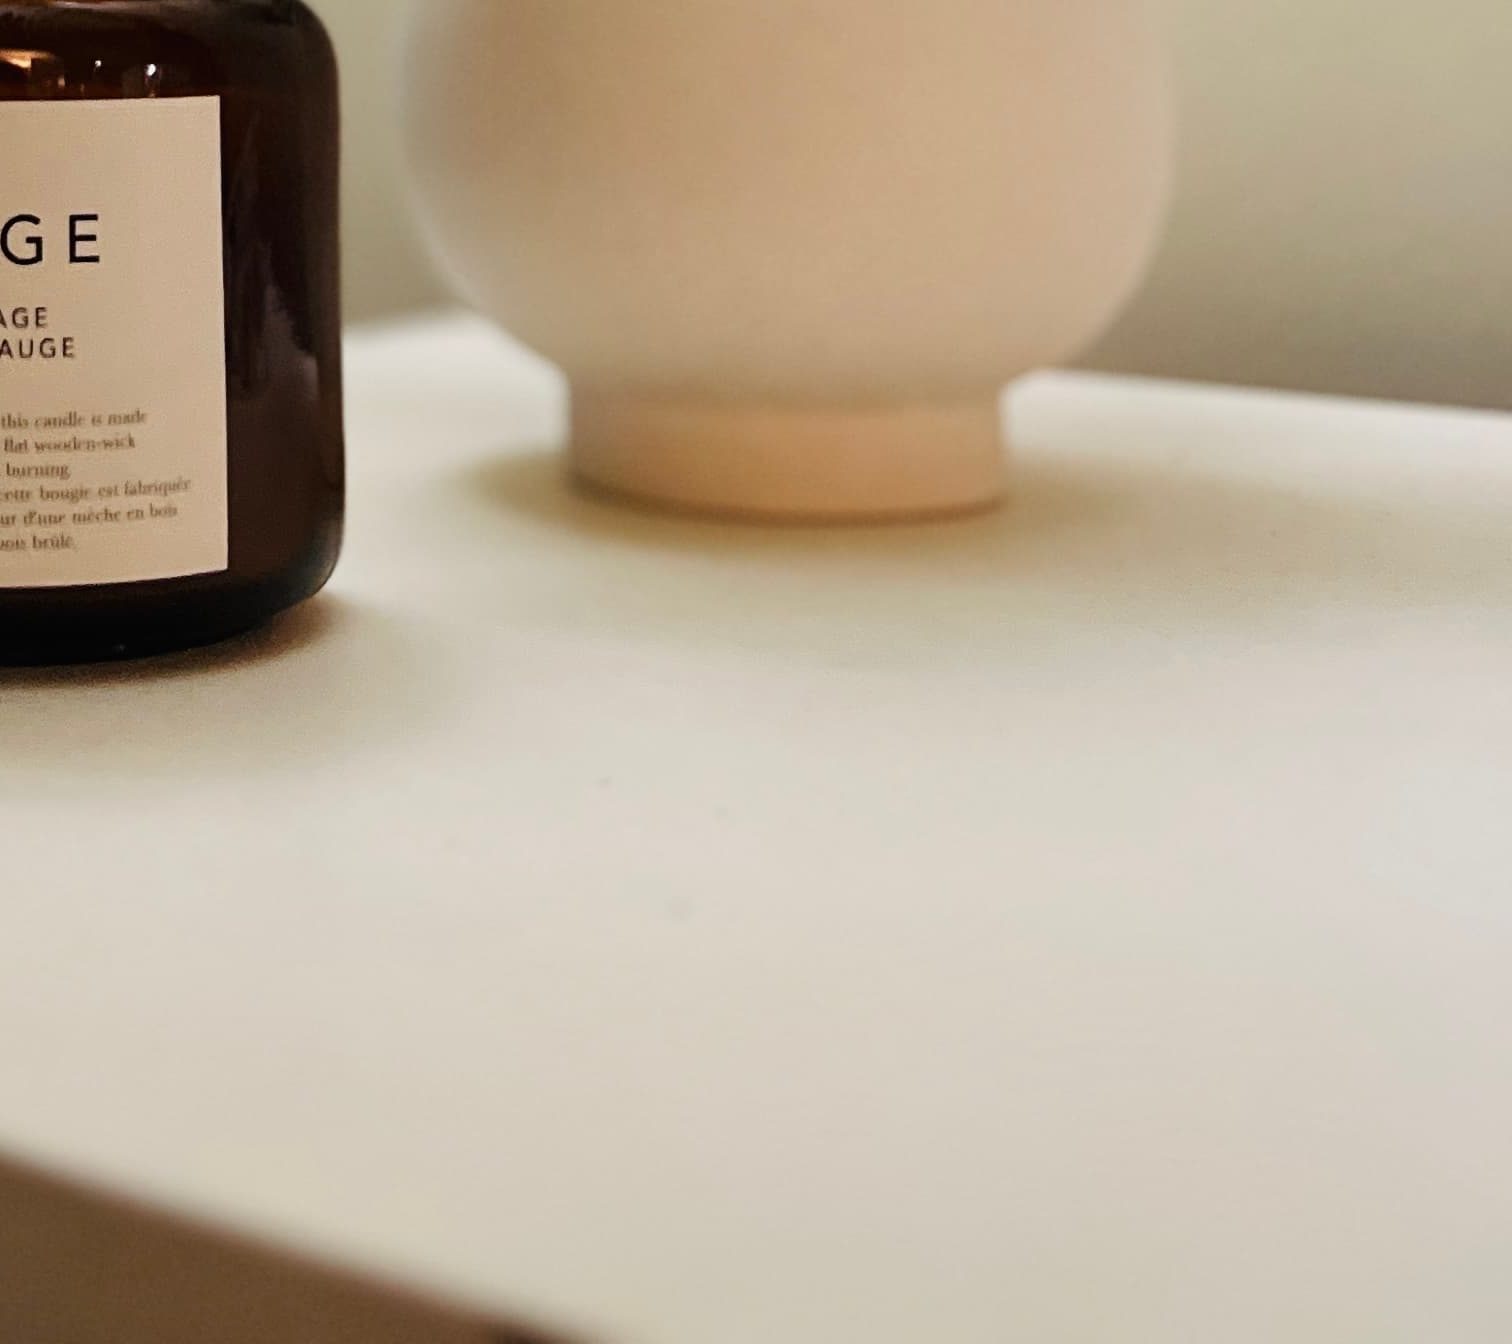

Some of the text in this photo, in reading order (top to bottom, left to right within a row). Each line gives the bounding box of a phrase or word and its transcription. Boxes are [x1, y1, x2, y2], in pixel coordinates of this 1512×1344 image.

[1, 412, 28, 429] this
[35, 411, 85, 428] candle
[108, 408, 147, 425] made
